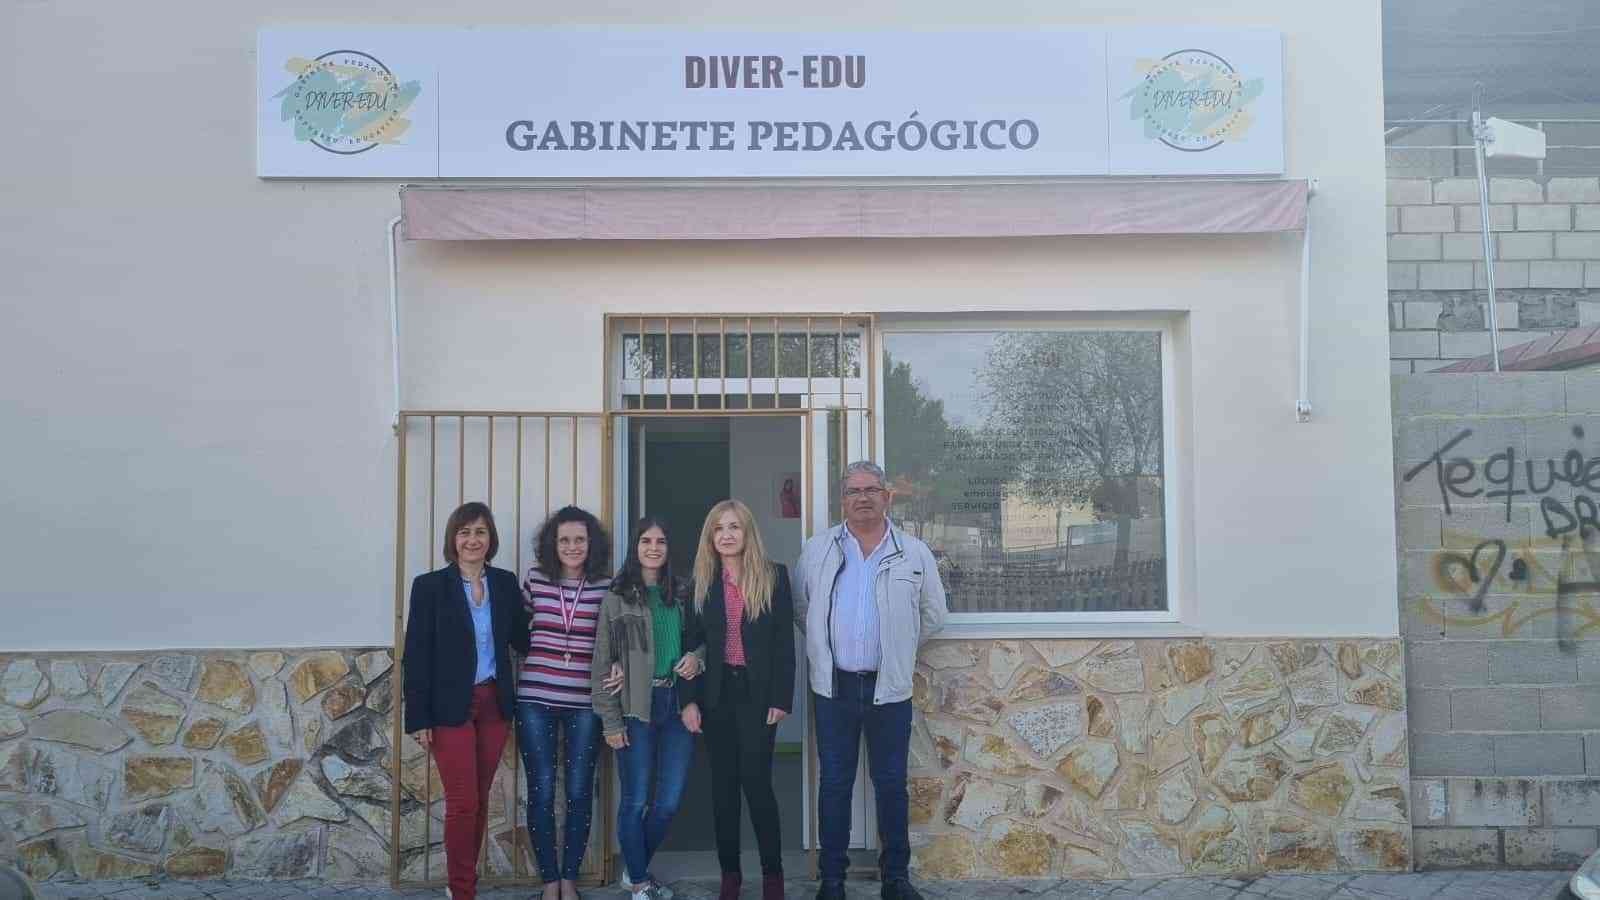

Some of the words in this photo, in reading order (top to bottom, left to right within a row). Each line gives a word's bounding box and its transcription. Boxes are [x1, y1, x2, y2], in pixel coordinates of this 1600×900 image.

[685, 55, 866, 88] DIVER-EDU
[304, 90, 389, 112] DIVER-EDU
[505, 120, 736, 151] GABINETE
[747, 111, 1039, 151] PEDAGÓGICO
